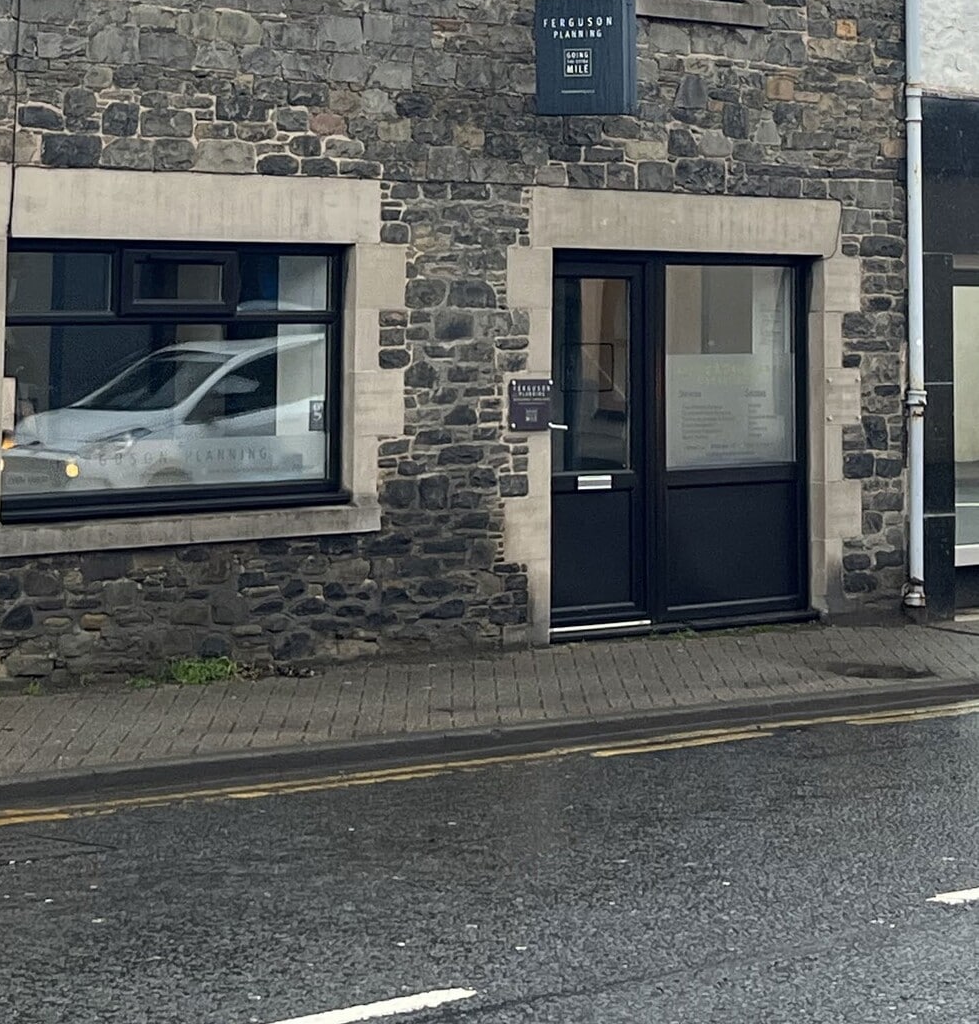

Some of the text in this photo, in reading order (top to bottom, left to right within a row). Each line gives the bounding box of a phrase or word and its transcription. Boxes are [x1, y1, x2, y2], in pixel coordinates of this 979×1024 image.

[543, 16, 613, 28] FERGUSON
[553, 29, 603, 39] PLANNING
[566, 51, 589, 59] GOING
[566, 64, 589, 74] MILE
[184, 447, 268, 464] PLANNING
